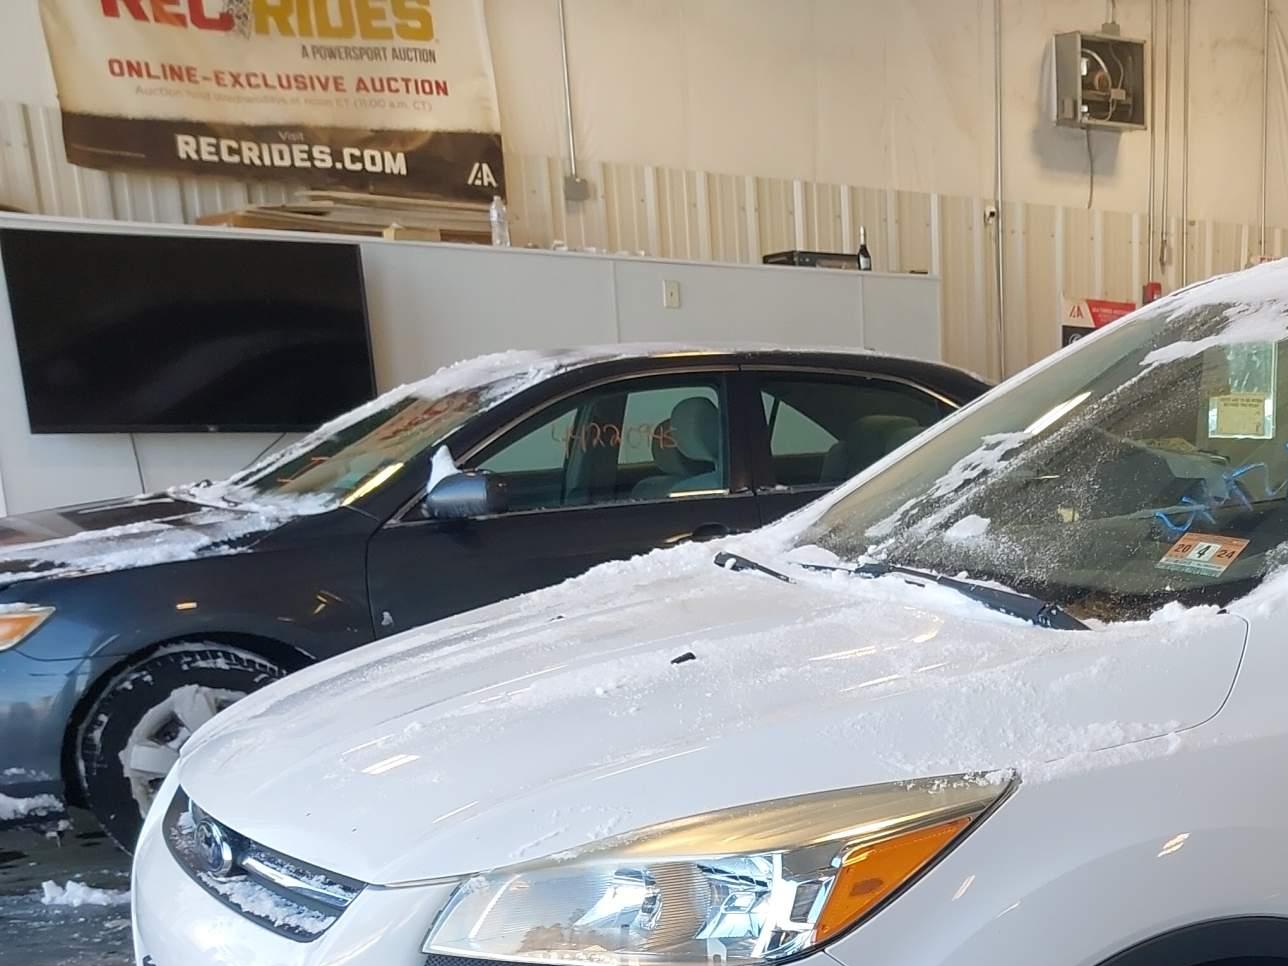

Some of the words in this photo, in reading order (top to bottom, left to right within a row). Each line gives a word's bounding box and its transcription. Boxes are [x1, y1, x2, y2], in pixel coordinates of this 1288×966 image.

[254, 0, 434, 41] RIDES
[301, 44, 311, 59] A
[311, 45, 388, 62] POWERSPORT
[391, 47, 436, 63] AUCTION
[108, 58, 346, 93] ONLINE-EXCLUSIVE
[355, 76, 449, 97] AUCTION
[175, 134, 407, 176] RECRIDES.COM
[1174, 543, 1192, 553] 20
[1197, 545, 1212, 559] 4
[1217, 549, 1236, 559] 24
